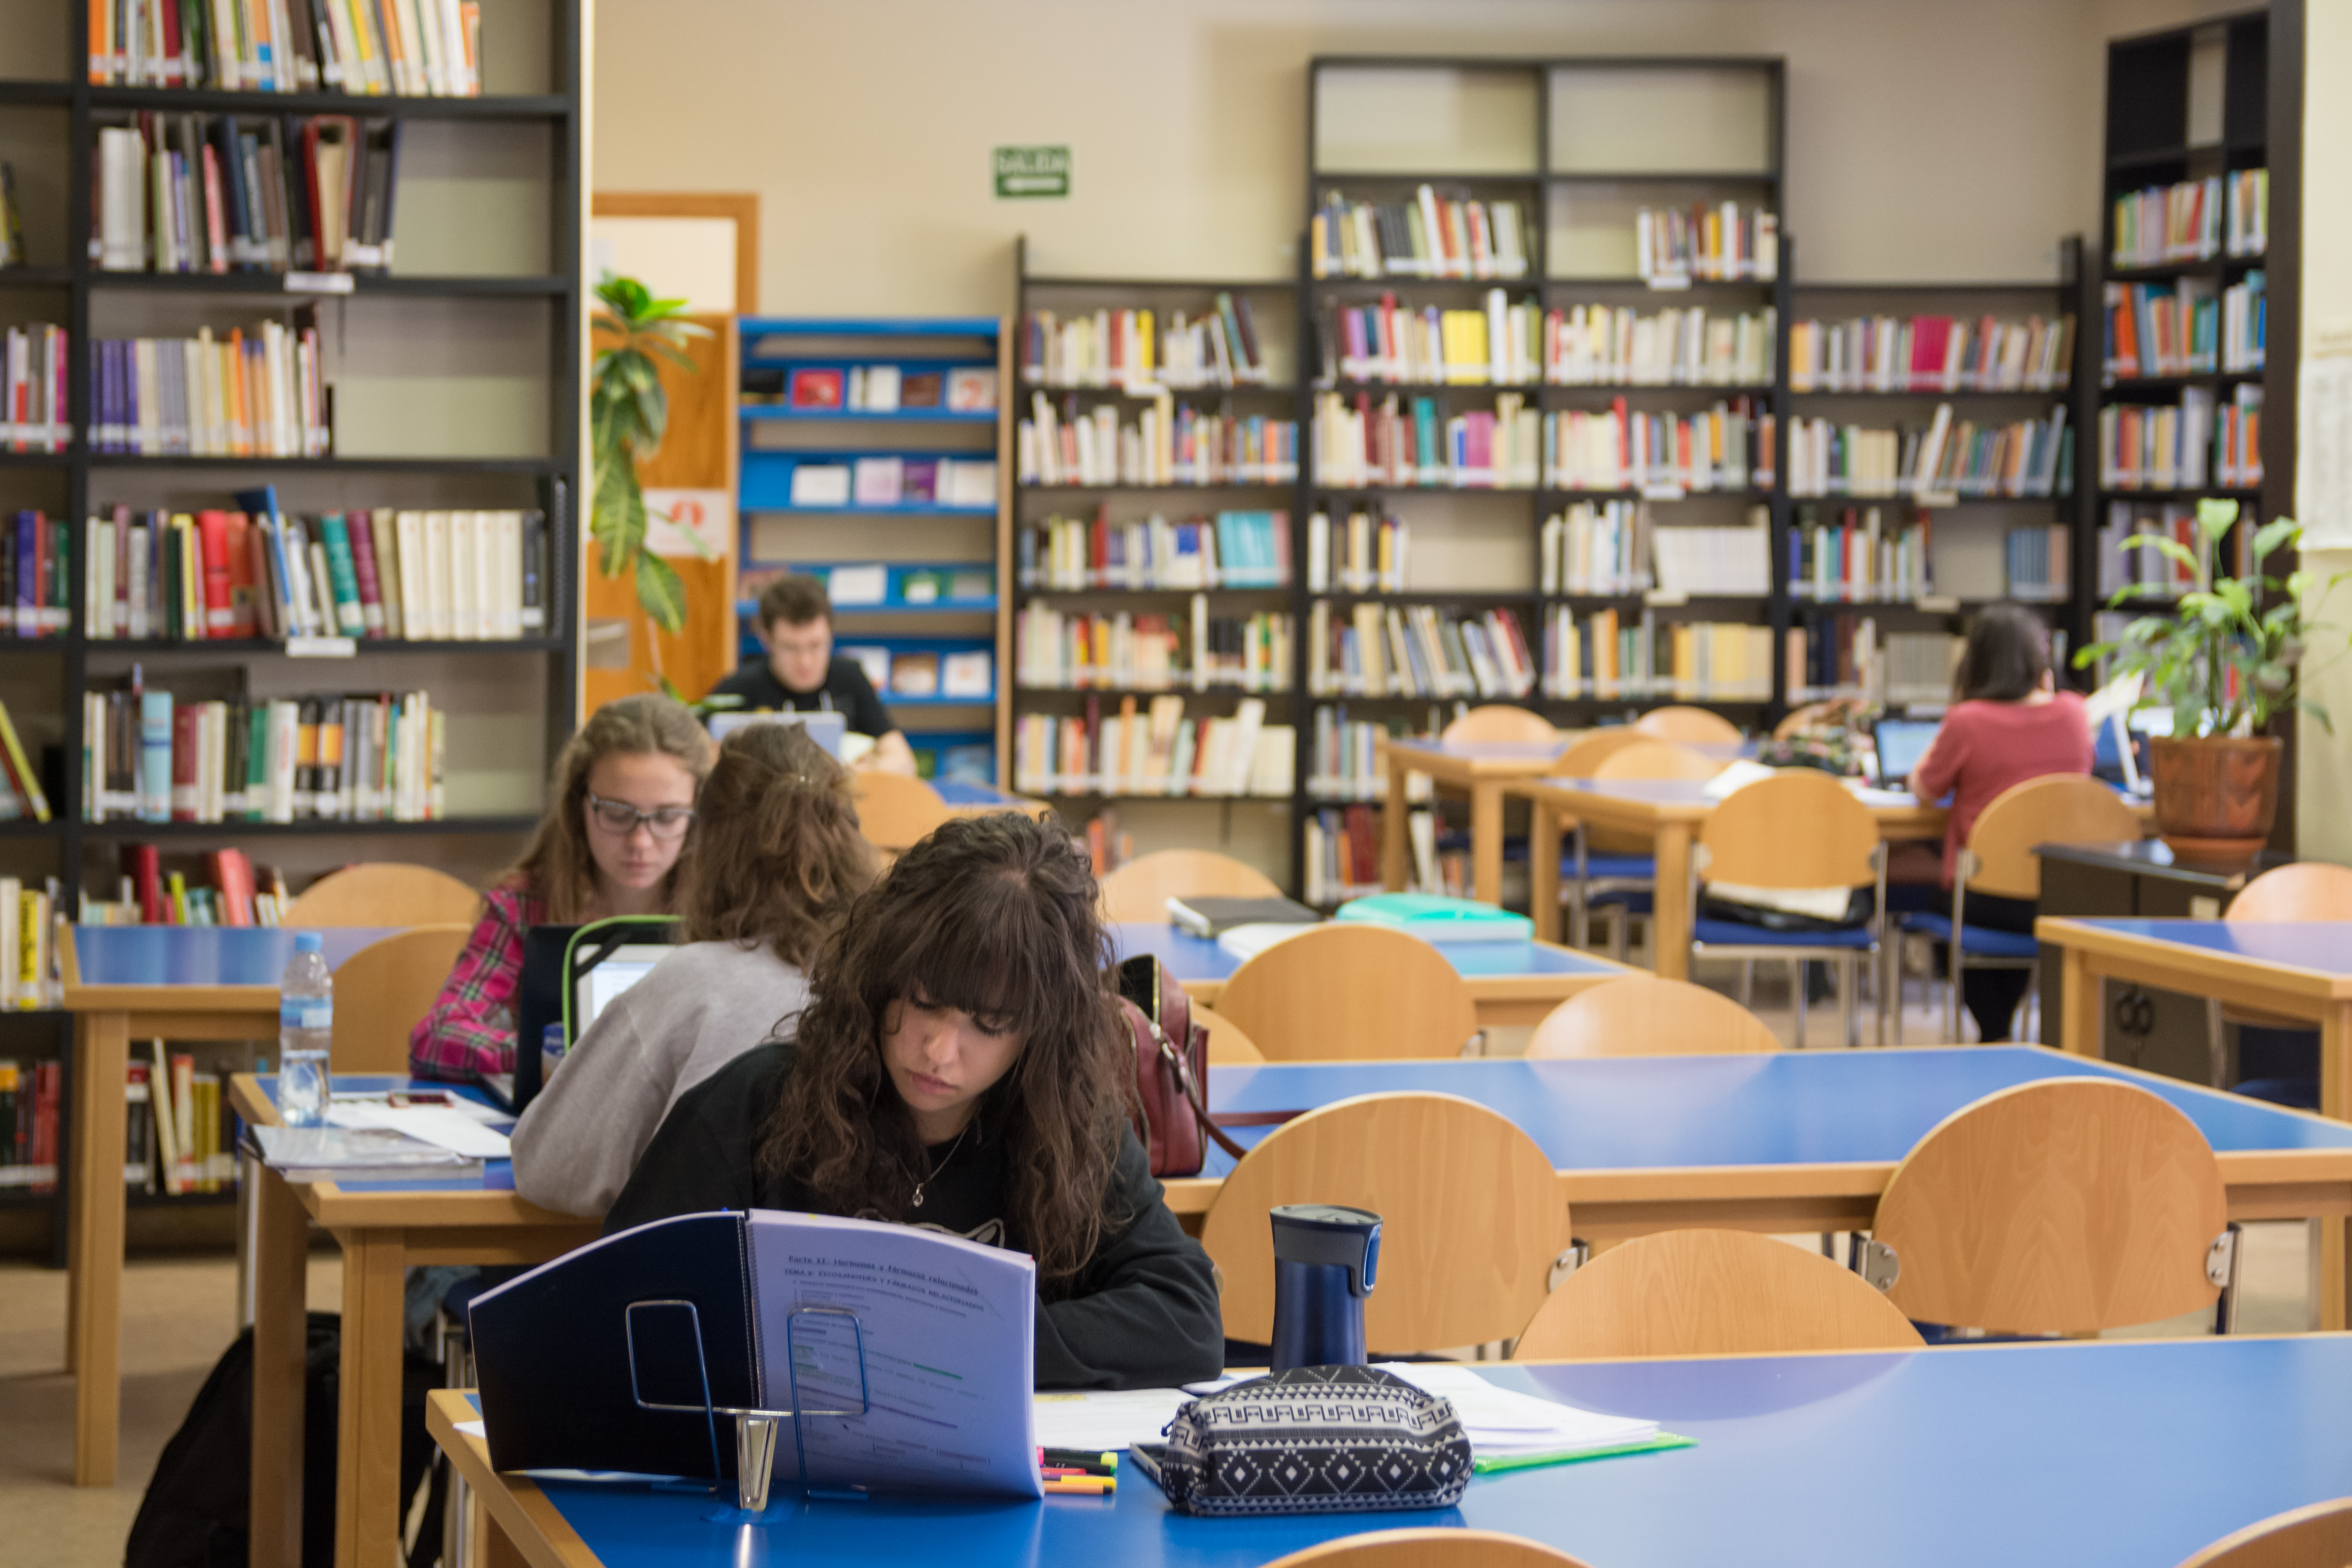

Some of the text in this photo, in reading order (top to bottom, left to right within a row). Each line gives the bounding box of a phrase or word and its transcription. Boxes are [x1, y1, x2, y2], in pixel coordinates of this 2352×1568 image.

[834, 1258, 876, 1270] Hormonas
[928, 1275, 978, 1296] relacionados
[928, 1289, 984, 1312] RELACIONADOS
